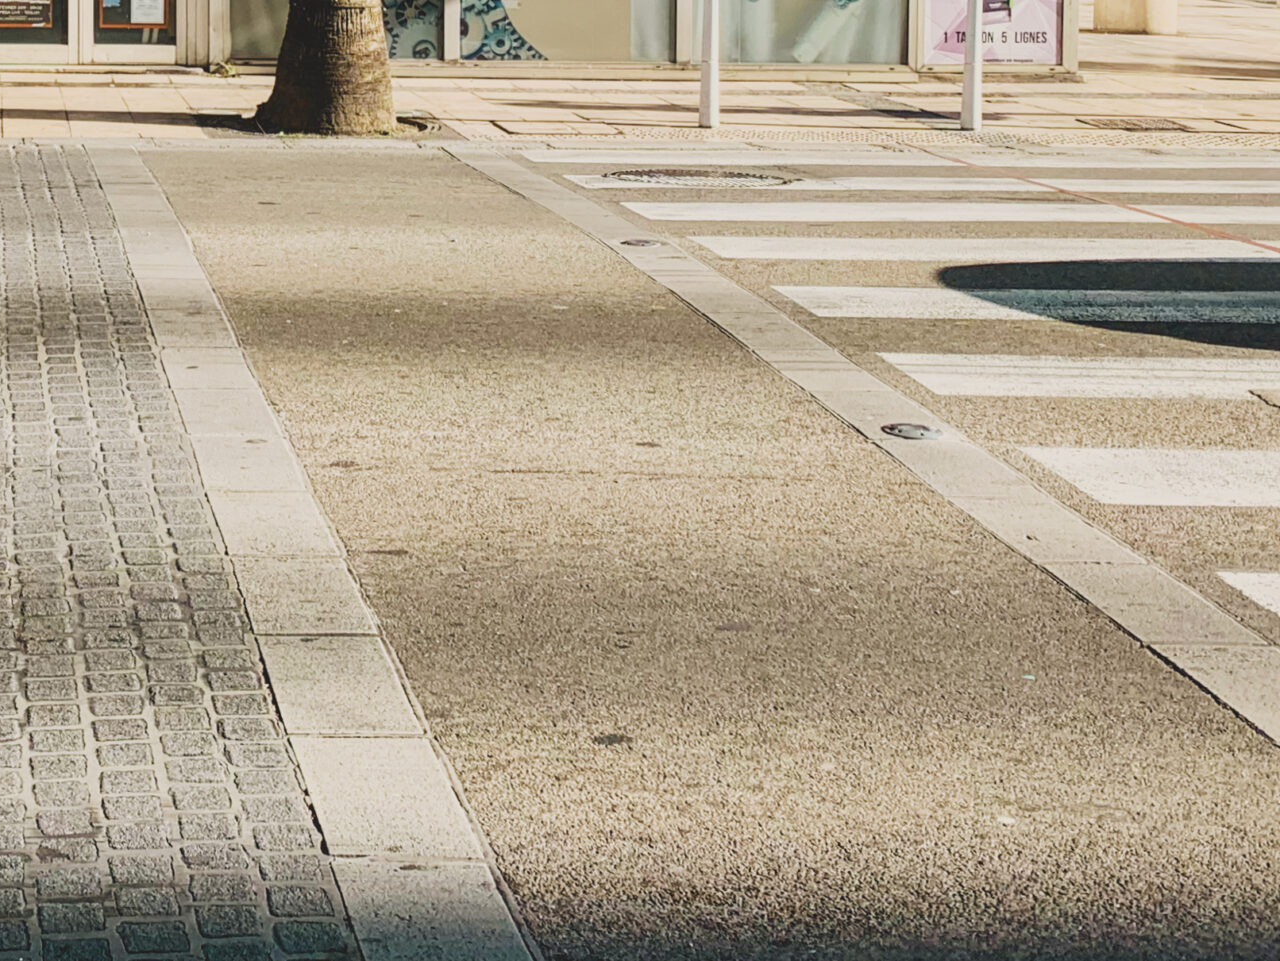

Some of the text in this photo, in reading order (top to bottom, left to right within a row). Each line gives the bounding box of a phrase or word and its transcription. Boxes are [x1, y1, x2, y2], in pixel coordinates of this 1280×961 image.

[943, 31, 1048, 44] 1 TAON 5 LIGNES
